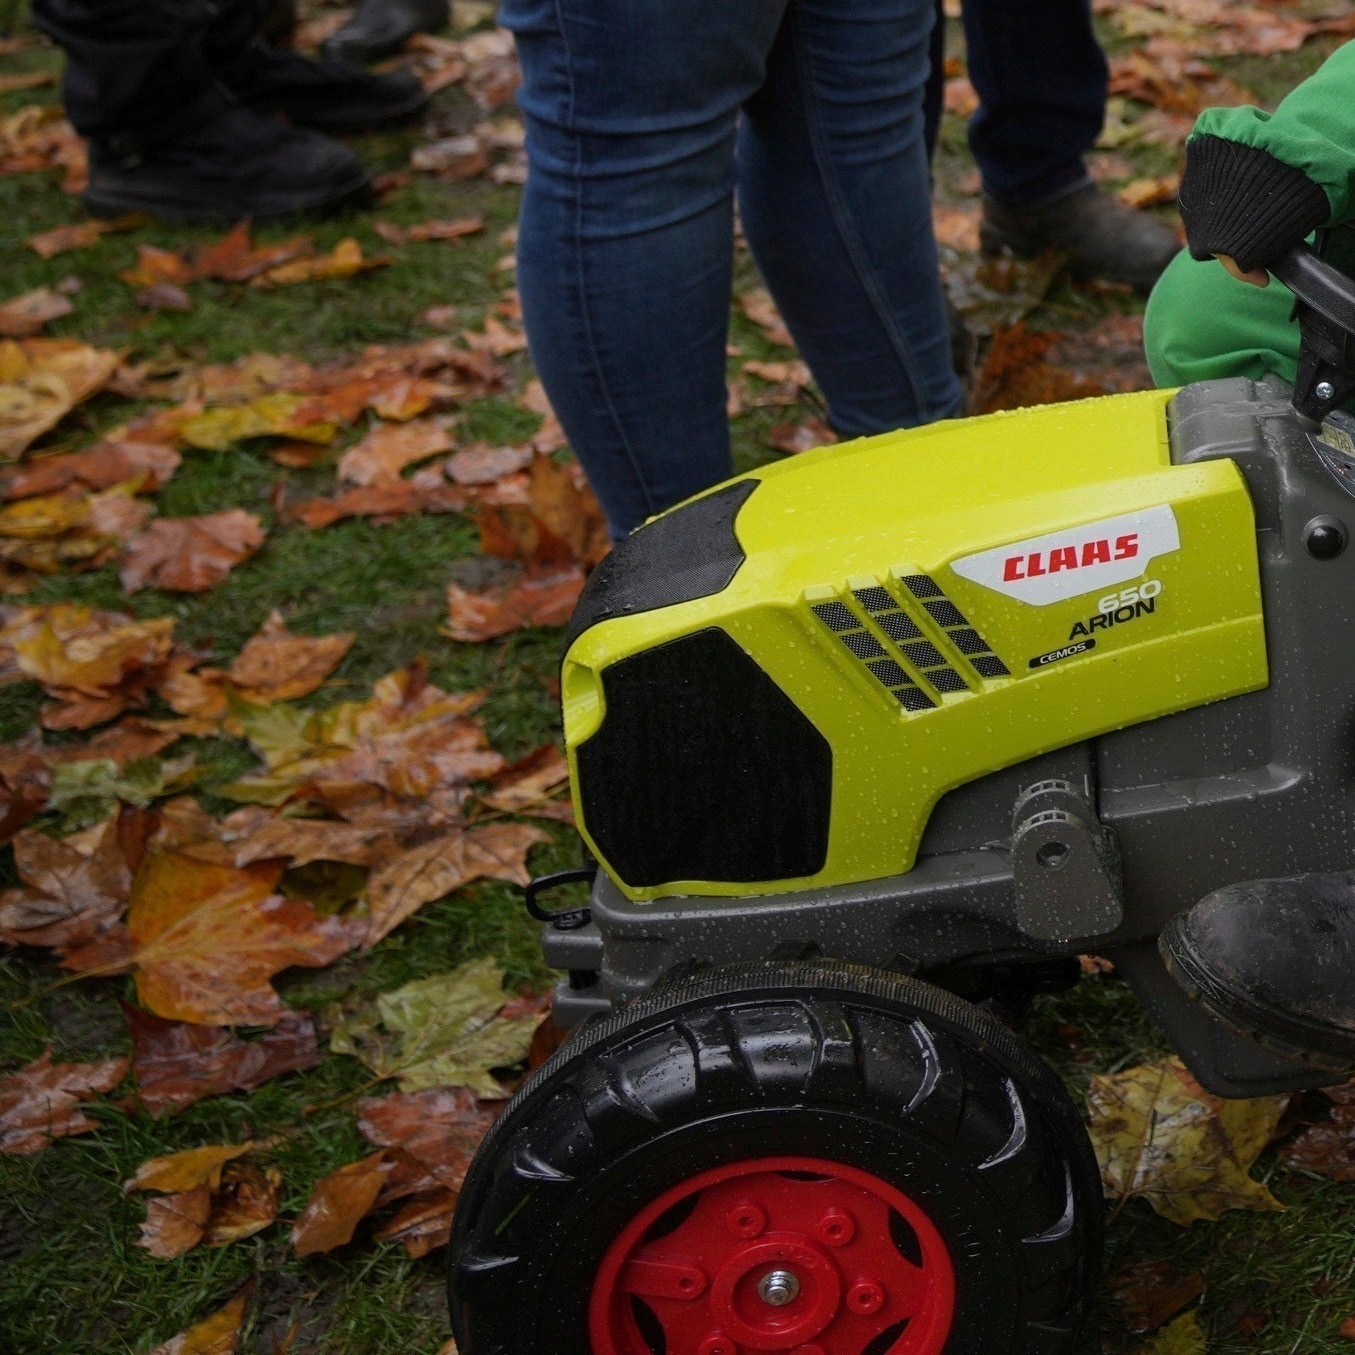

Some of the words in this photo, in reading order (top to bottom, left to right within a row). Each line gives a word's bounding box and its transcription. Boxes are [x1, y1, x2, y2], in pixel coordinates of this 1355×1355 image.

[1003, 534, 1138, 581] CLAAS
[1098, 580, 1162, 614] 650
[1069, 597, 1155, 641] ARION
[1040, 642, 1086, 664] CEMOS
